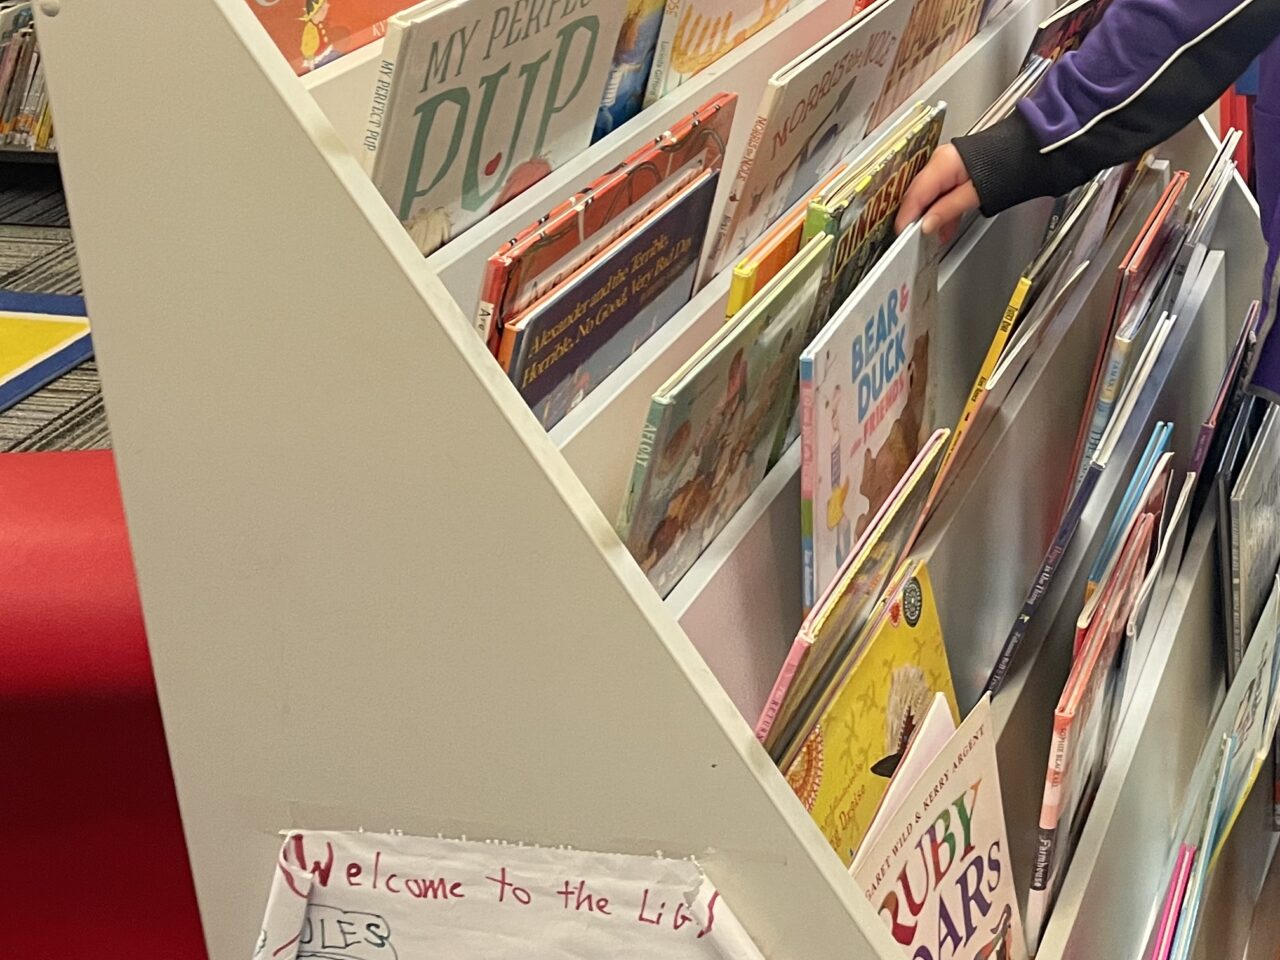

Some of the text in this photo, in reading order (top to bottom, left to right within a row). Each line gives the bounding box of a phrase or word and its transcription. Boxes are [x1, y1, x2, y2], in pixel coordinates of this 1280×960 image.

[420, 19, 481, 93] MY
[365, 60, 395, 152] MY PERFECT PUP
[398, 14, 600, 221] PUP
[852, 288, 898, 385] BEAR
[857, 323, 906, 425] DUCK
[634, 420, 659, 469] AFLOAT
[892, 822, 913, 857] WILD
[923, 772, 950, 812] KERRY
[952, 723, 986, 773] ARGENT
[485, 867, 532, 906] to
[557, 880, 612, 916] the
